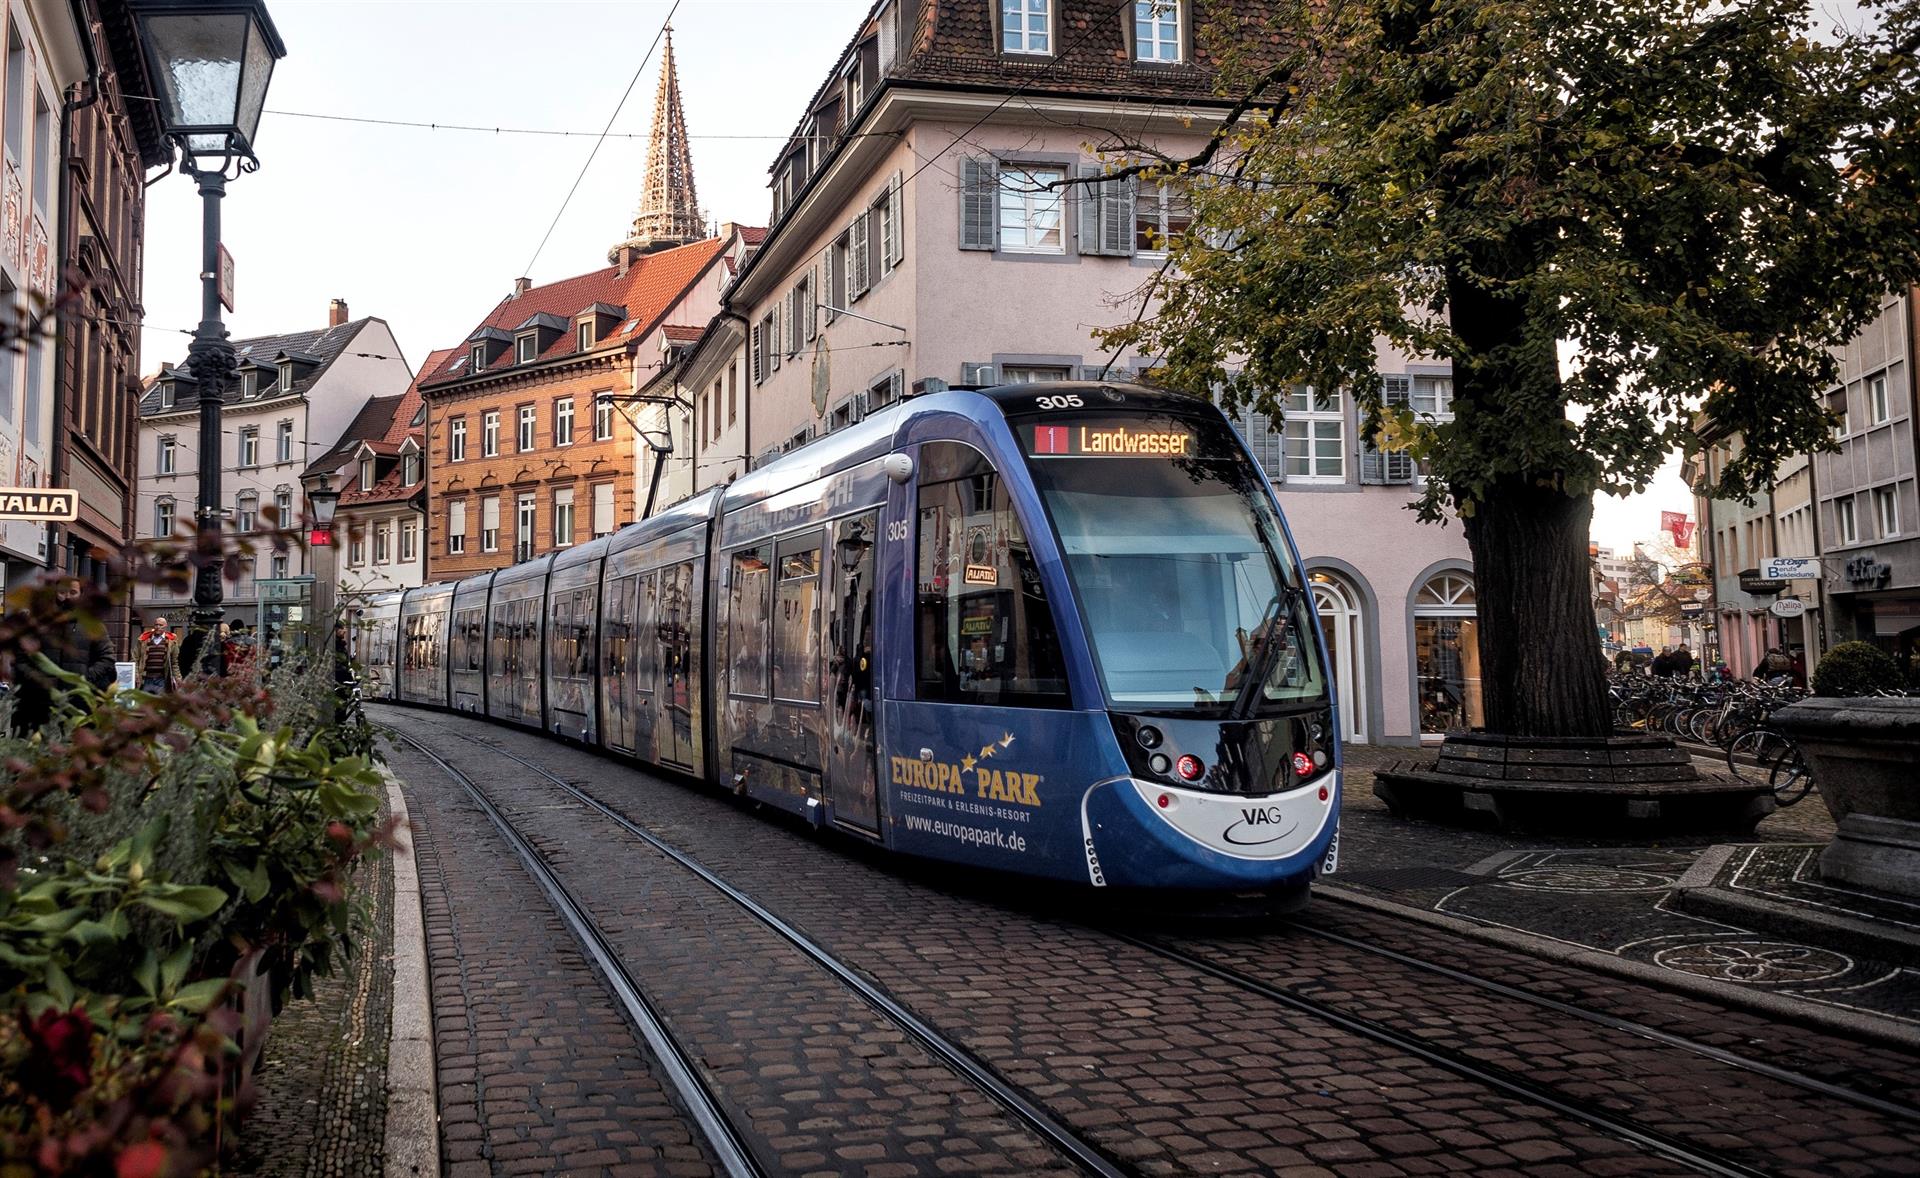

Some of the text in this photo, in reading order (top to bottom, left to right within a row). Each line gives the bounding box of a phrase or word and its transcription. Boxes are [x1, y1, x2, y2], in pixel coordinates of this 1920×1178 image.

[1036, 394, 1084, 410] 305
[1048, 426, 1189, 453] 1 Landwasser
[888, 520, 907, 542] 305
[891, 756, 1041, 807] EUROPA PARK
[900, 791, 947, 808] FREIZEITPARK
[955, 801, 1031, 823] ERLEBNIS-RESORT
[1241, 806, 1282, 825] VAG
[904, 814, 1027, 852] www.europapark.de
